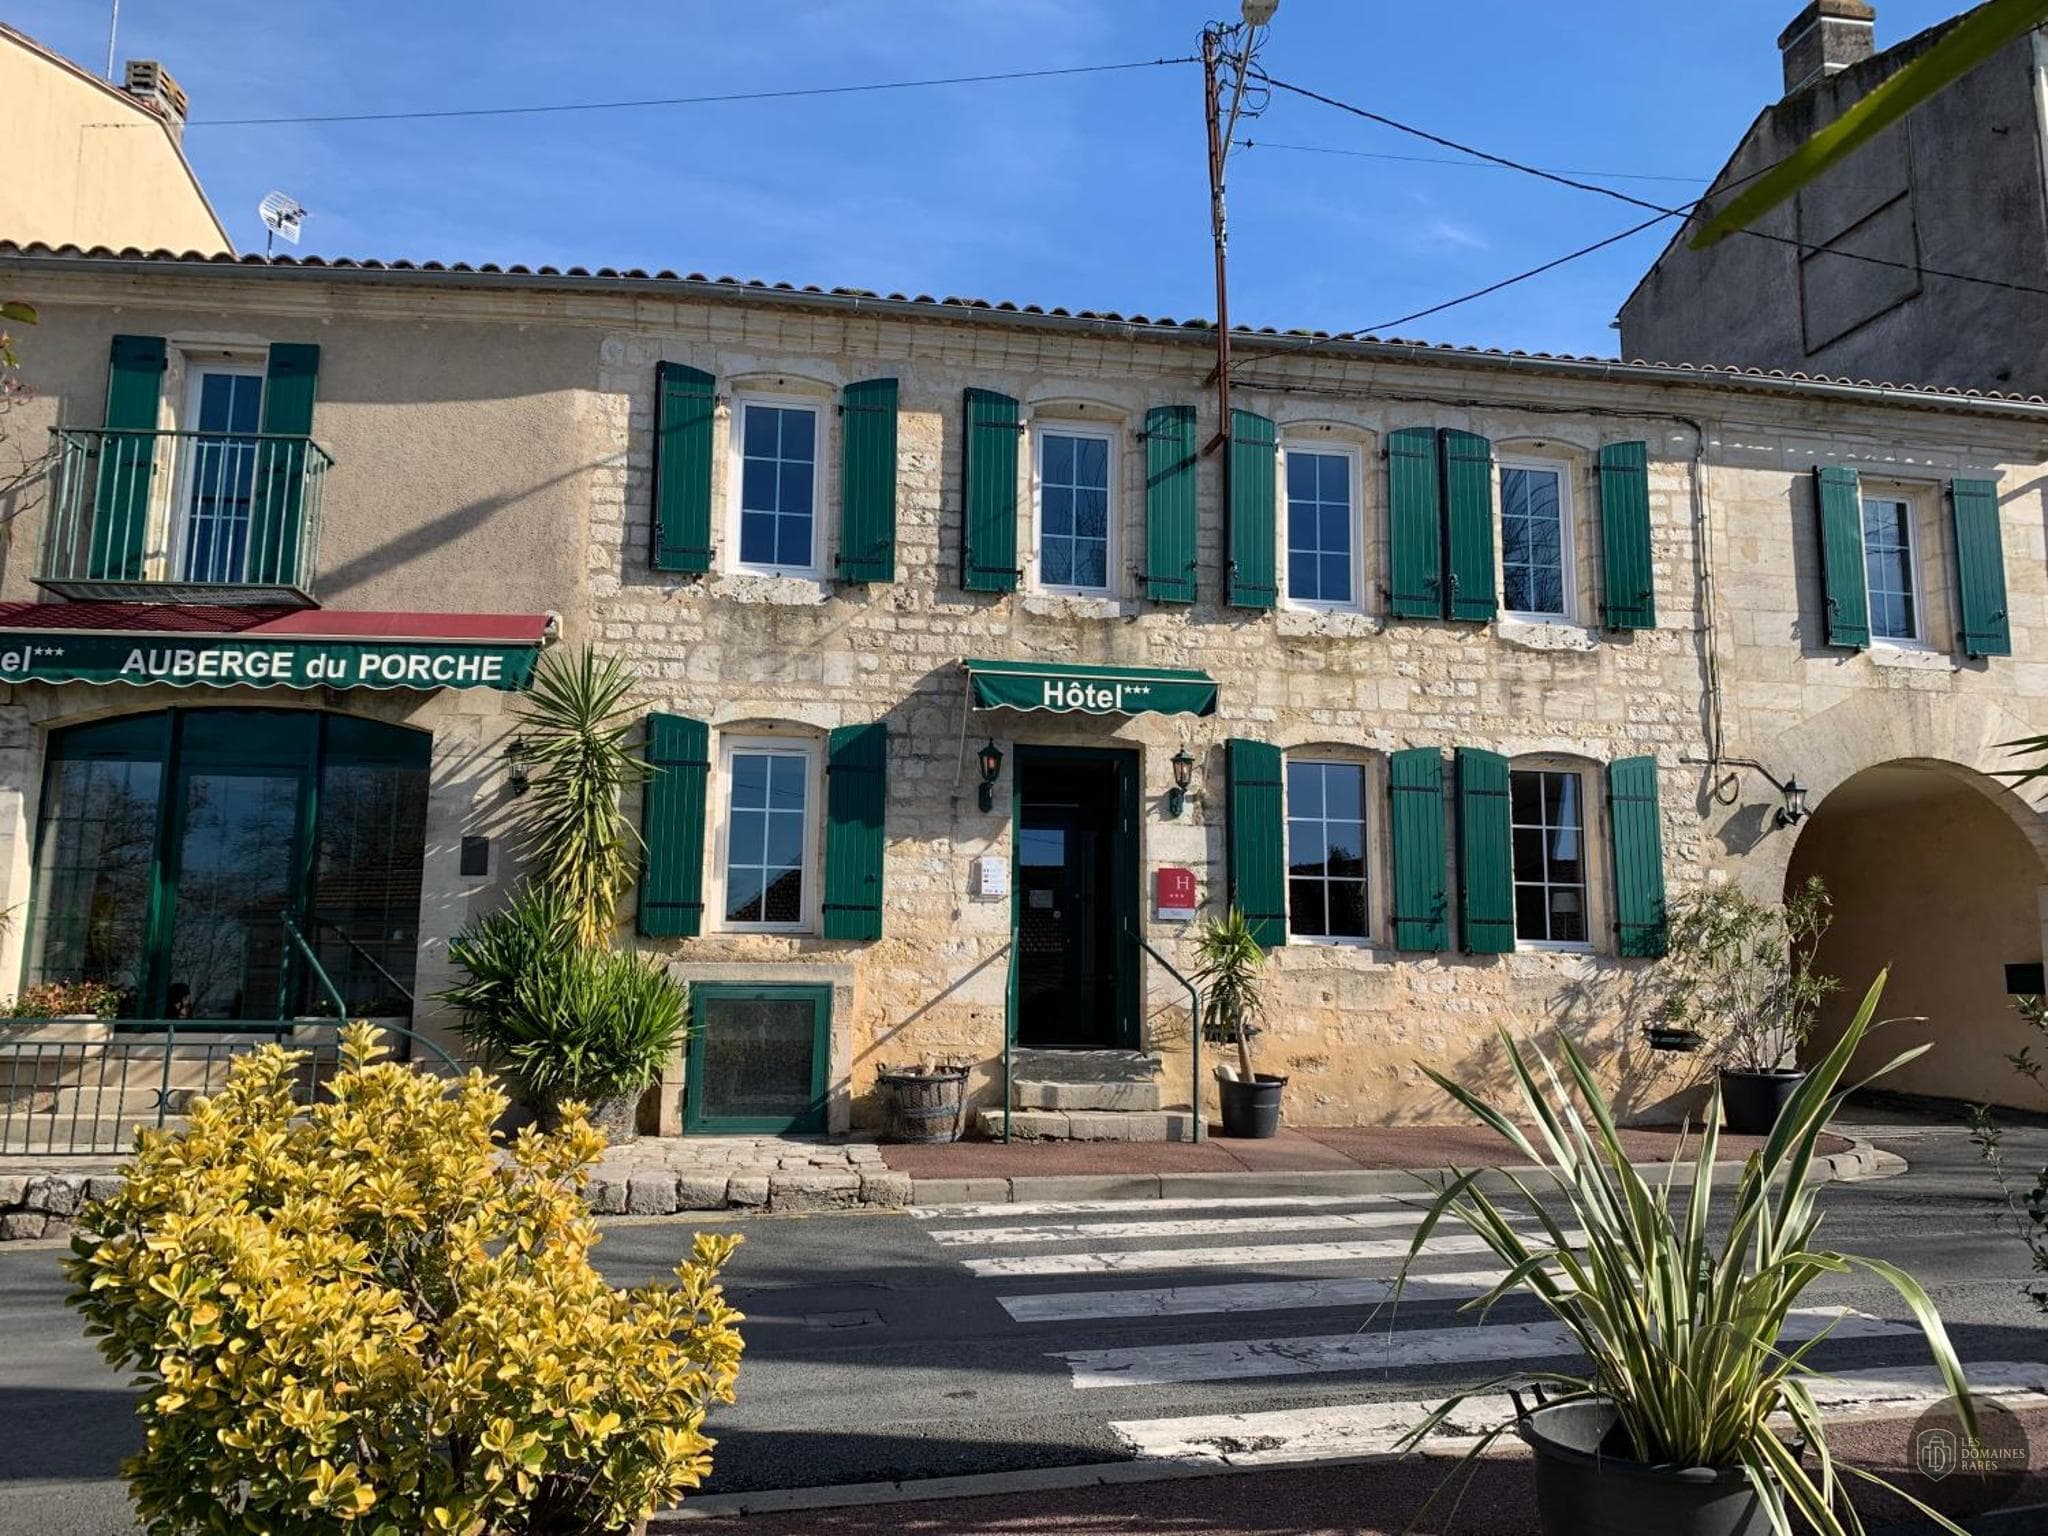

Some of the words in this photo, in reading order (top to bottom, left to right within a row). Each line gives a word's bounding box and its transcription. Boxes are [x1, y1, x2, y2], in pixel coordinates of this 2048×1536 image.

[0, 645, 32, 673] el
[120, 648, 294, 678] AUBERGE
[306, 653, 347, 679] du
[358, 654, 503, 681] PORCHE
[1043, 681, 1122, 709] Hôtel
[1176, 875, 1189, 890] H
